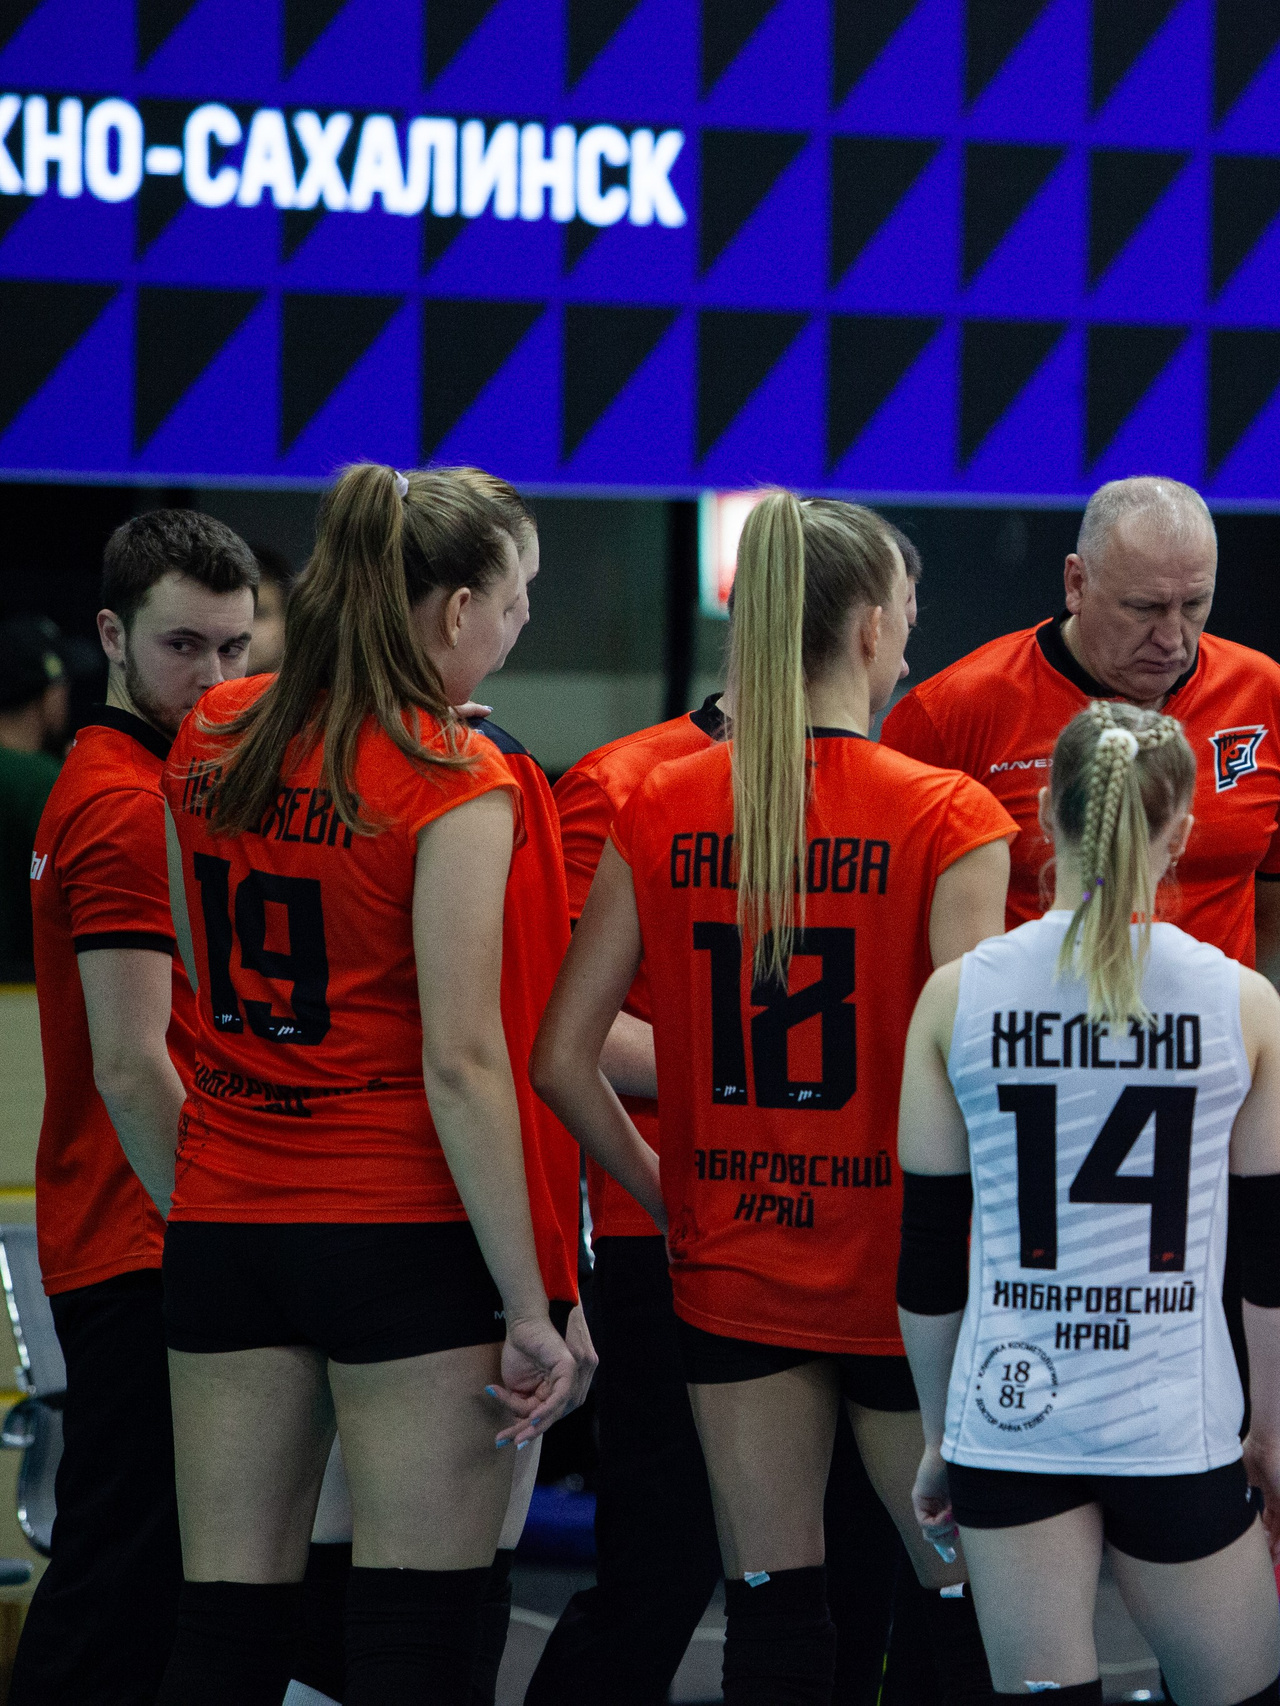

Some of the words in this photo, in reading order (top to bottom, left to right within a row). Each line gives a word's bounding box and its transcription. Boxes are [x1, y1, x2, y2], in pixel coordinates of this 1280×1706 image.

[670, 832, 892, 895] БАСОВА
[193, 851, 331, 1046] 19
[693, 921, 858, 1111] 18
[992, 1010, 1202, 1070] ЖЕЛЕЗКО
[694, 1149, 892, 1188] АБАРОВСКИЙ
[996, 1083, 1199, 1273] 14
[733, 1191, 814, 1229] КРАЙ
[993, 1279, 1197, 1313] ХАБАРОВСКИЙ
[1055, 1318, 1131, 1351] КРАЙ
[1001, 1360, 1031, 1383] 18
[999, 1384, 1026, 1409] 81
